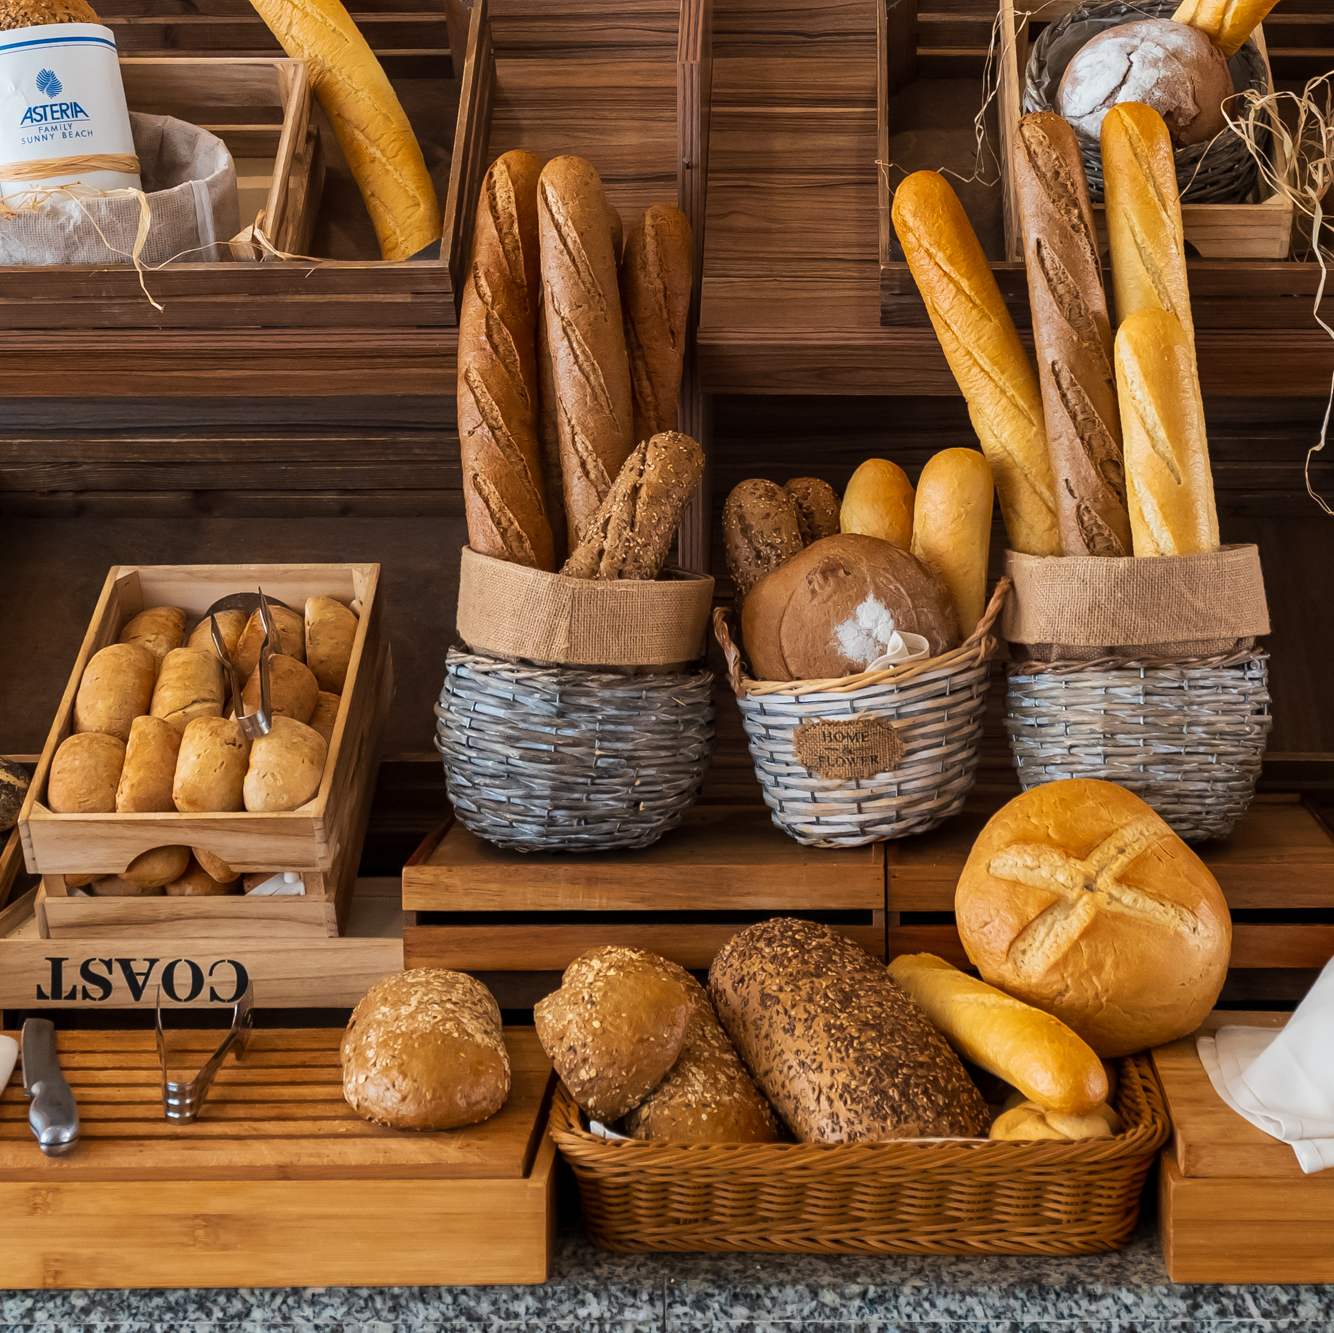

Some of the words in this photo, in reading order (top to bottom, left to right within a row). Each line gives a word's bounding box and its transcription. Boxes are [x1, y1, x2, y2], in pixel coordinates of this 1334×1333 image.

[20, 101, 90, 125] ASTERIA
[38, 122, 73, 134] FAMILY
[21, 132, 55, 145] SUNNY
[61, 129, 94, 139] BEACH
[822, 730, 870, 744] HOME
[818, 754, 879, 768] FLOWER
[35, 956, 250, 1004] COAST
